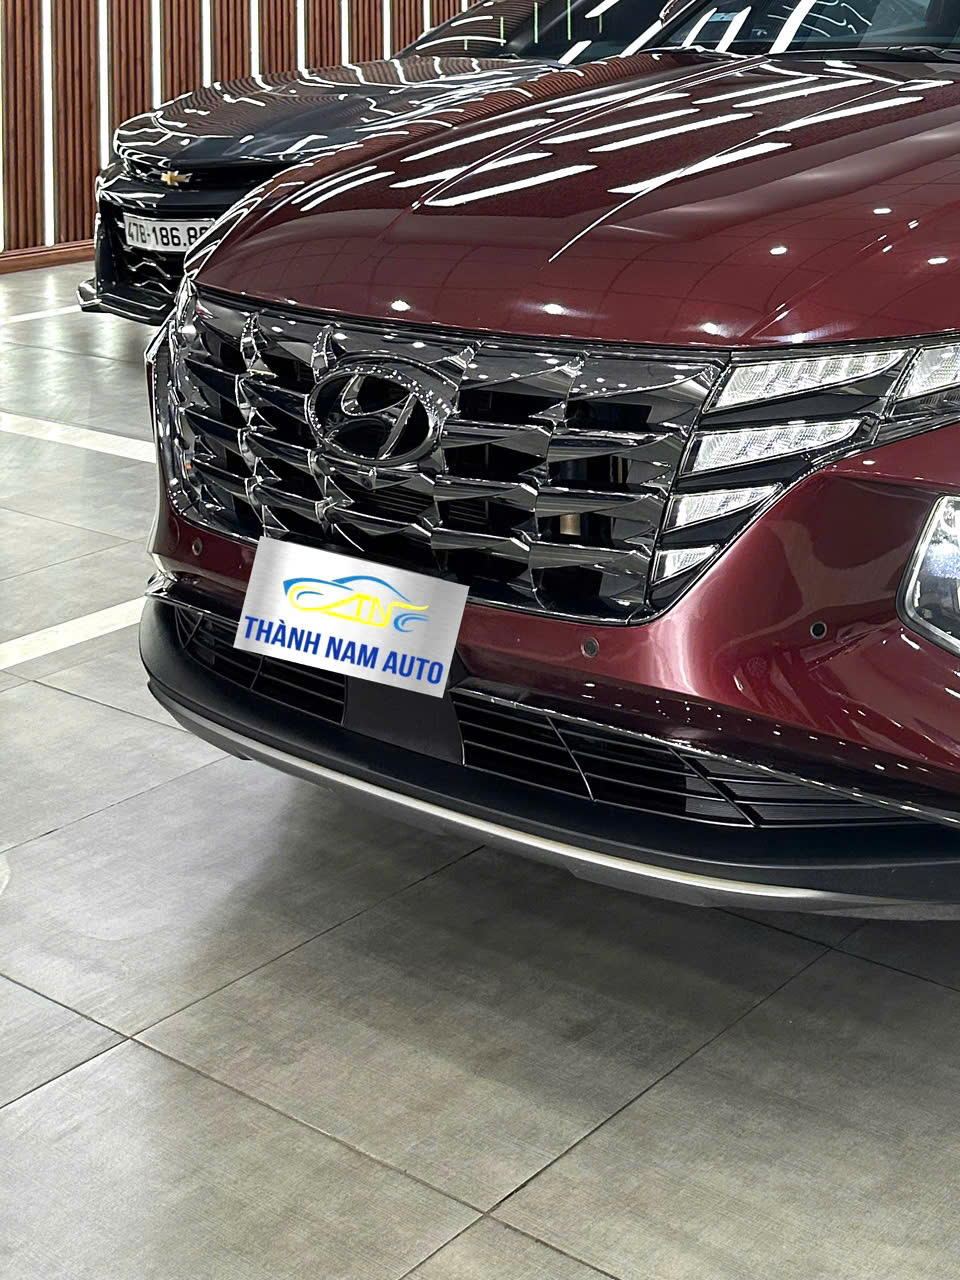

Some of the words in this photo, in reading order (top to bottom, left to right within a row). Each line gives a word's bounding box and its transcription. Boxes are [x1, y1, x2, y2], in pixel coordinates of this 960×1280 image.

[128, 222, 209, 246] 47B-186.8
[244, 615, 321, 655] THÀNH
[325, 636, 379, 669] NAM
[382, 651, 444, 685] AUTO
